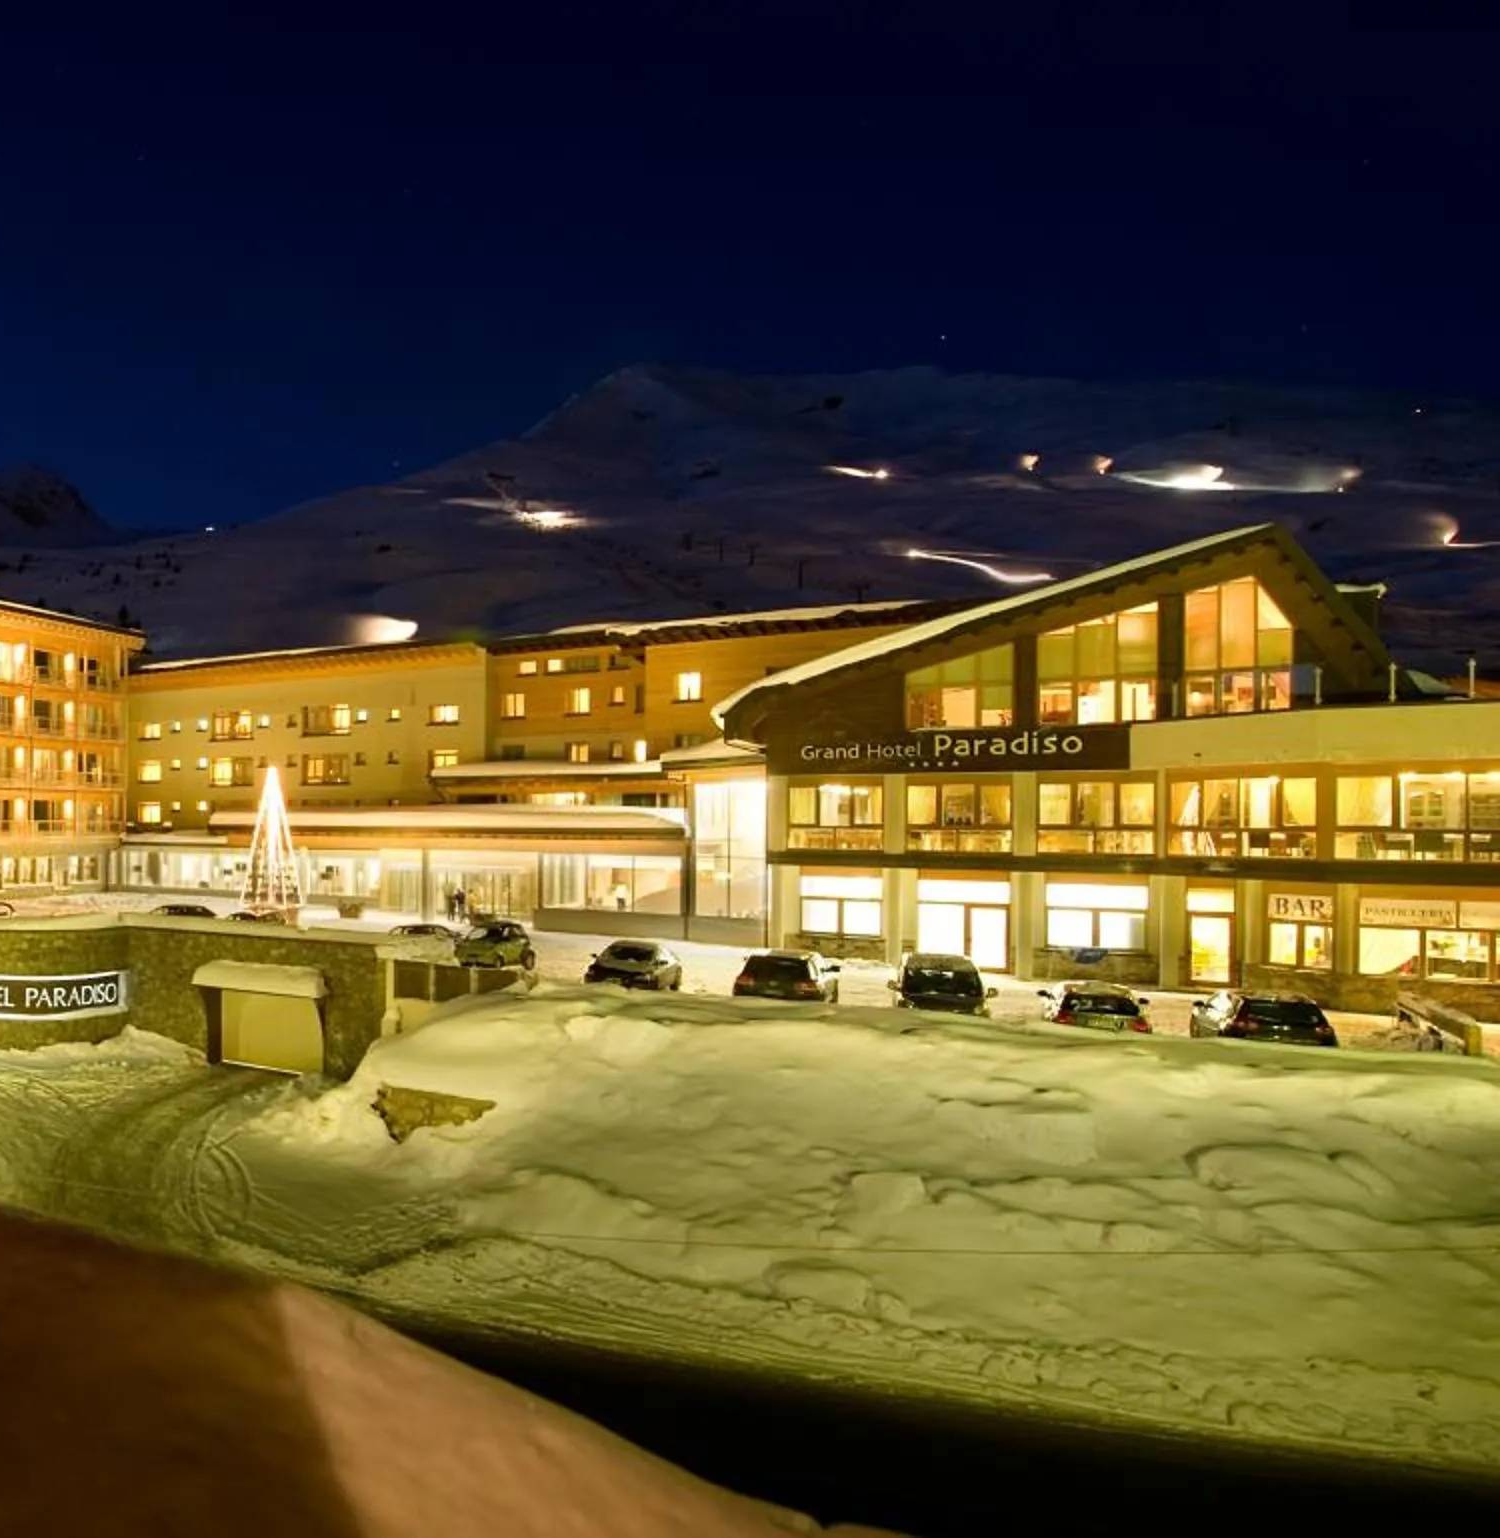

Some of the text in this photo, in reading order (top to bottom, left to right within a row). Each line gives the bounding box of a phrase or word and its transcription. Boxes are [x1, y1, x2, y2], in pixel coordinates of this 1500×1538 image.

[801, 731, 1083, 761] Grand Hotel Paradiso
[1275, 897, 1327, 917] BAR
[25, 983, 117, 1008] PARADISO
